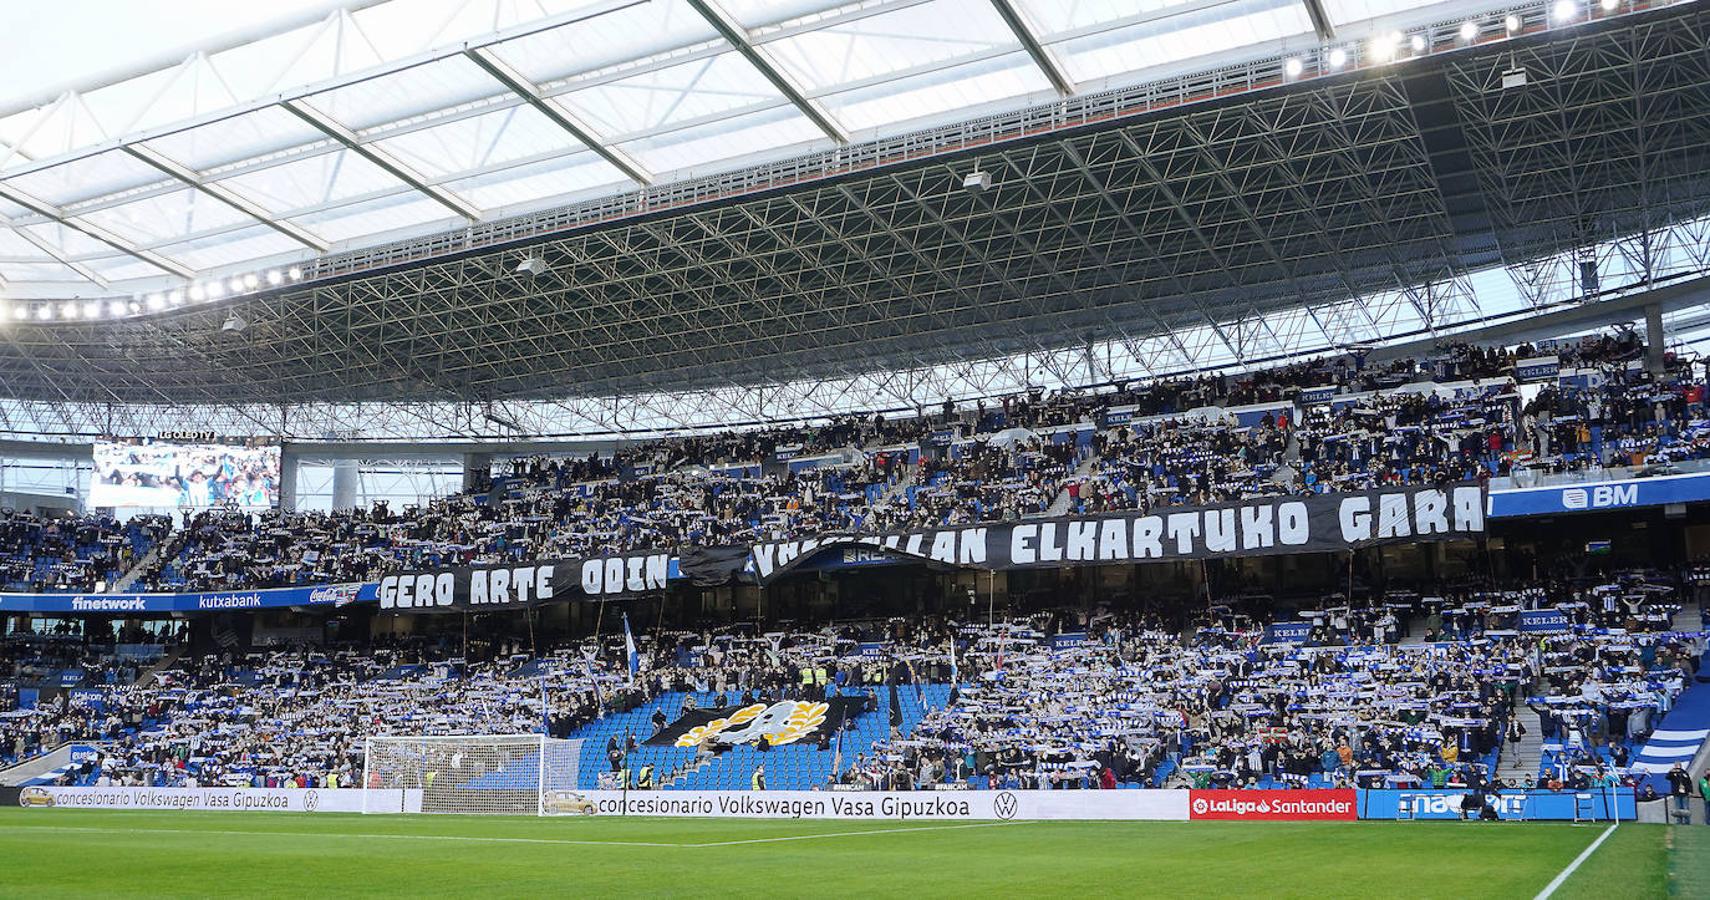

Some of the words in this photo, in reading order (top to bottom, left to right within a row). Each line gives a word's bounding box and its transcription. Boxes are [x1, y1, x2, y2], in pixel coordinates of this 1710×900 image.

[159, 431, 171, 439] LG
[173, 431, 198, 439] OLED
[200, 431, 212, 440] TV
[1593, 484, 1638, 508] BM
[380, 573, 455, 609] GERO
[470, 565, 554, 604] ARTE
[581, 554, 667, 594] ODIN
[1011, 502, 1309, 564] ELKARTUKO
[1339, 486, 1484, 543] GARA
[71, 596, 146, 610] finetwork
[199, 593, 261, 608] kutxabank
[1523, 616, 1568, 625] KELER
[57, 791, 129, 805] concesionario
[134, 791, 199, 810] Volkswagen
[204, 792, 229, 808] Vasa
[233, 792, 288, 811] Gipuzkoa
[599, 796, 713, 814] concesionario
[718, 796, 825, 819] Volkswagen
[832, 797, 874, 816] Vasa
[881, 797, 970, 819] Gipuzkoa
[1210, 798, 1256, 814] LaLiga
[1272, 799, 1352, 813] Santander
